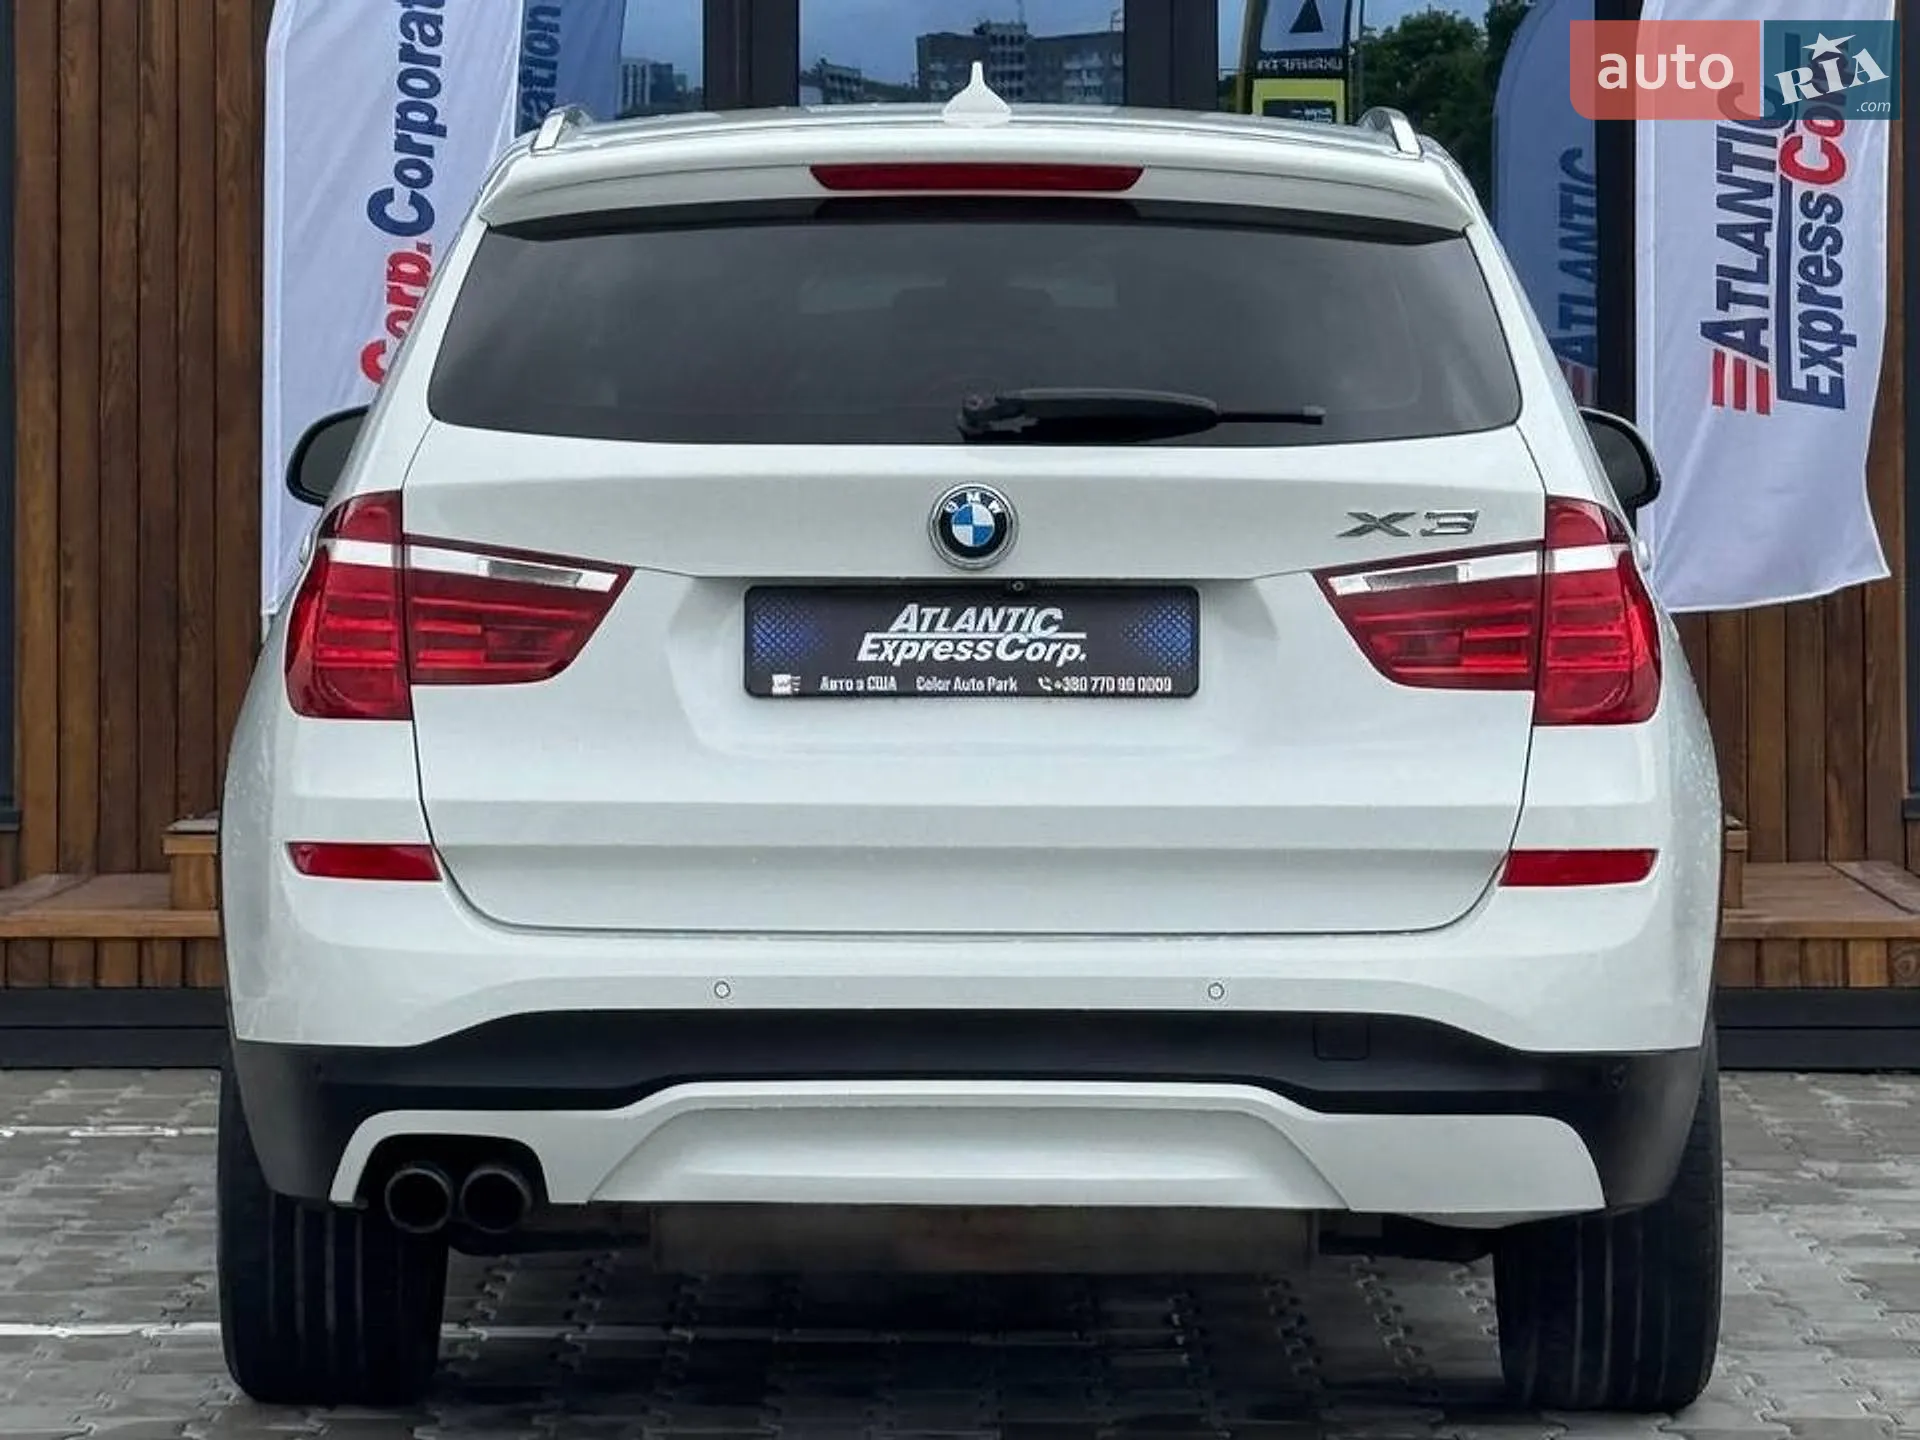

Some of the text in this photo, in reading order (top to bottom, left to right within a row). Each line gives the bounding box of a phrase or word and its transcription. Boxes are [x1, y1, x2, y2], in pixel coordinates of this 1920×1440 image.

[1700, 82, 1794, 364] ATLANTIC
[1335, 511, 1479, 537] X3
[888, 603, 1064, 636] ATLANTIC
[820, 675, 854, 691] Авто
[867, 675, 897, 691] США
[953, 676, 985, 692] Auto
[987, 676, 1017, 692] Park
